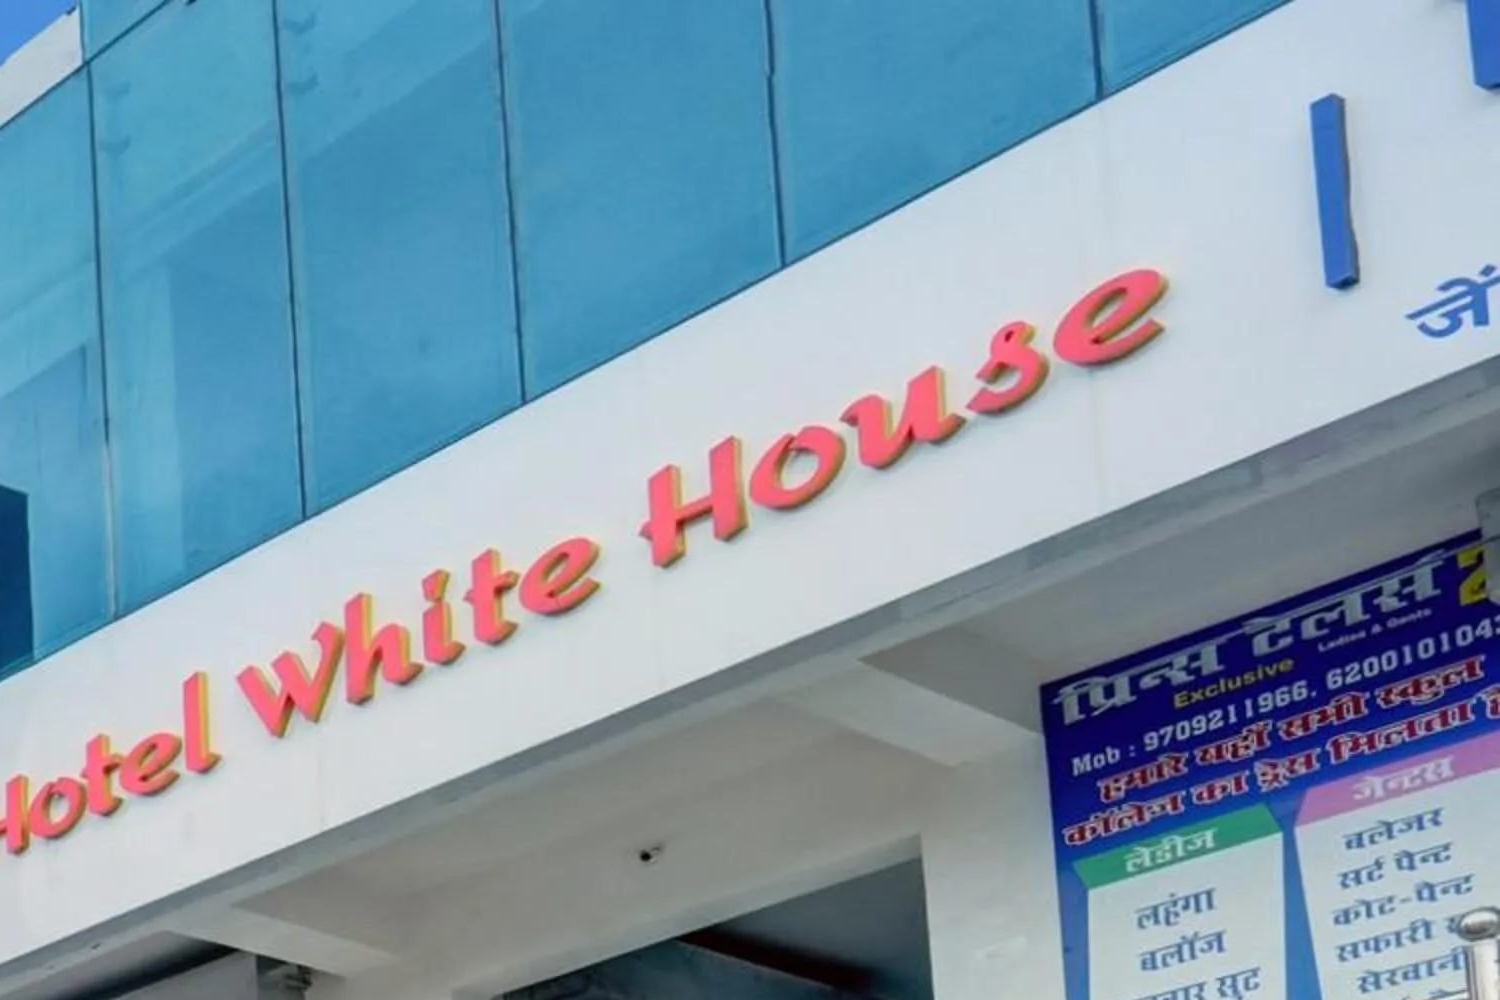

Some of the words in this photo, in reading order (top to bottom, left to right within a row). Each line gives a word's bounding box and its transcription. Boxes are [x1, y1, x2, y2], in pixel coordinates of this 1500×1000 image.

[237, 535, 601, 737] White
[639, 267, 1169, 568] House
[1173, 658, 1295, 709] Exclusive
[1123, 828, 1218, 873] लेडीज
[1134, 887, 1217, 930] लहंगा
[1335, 918, 1435, 962] सफारी
